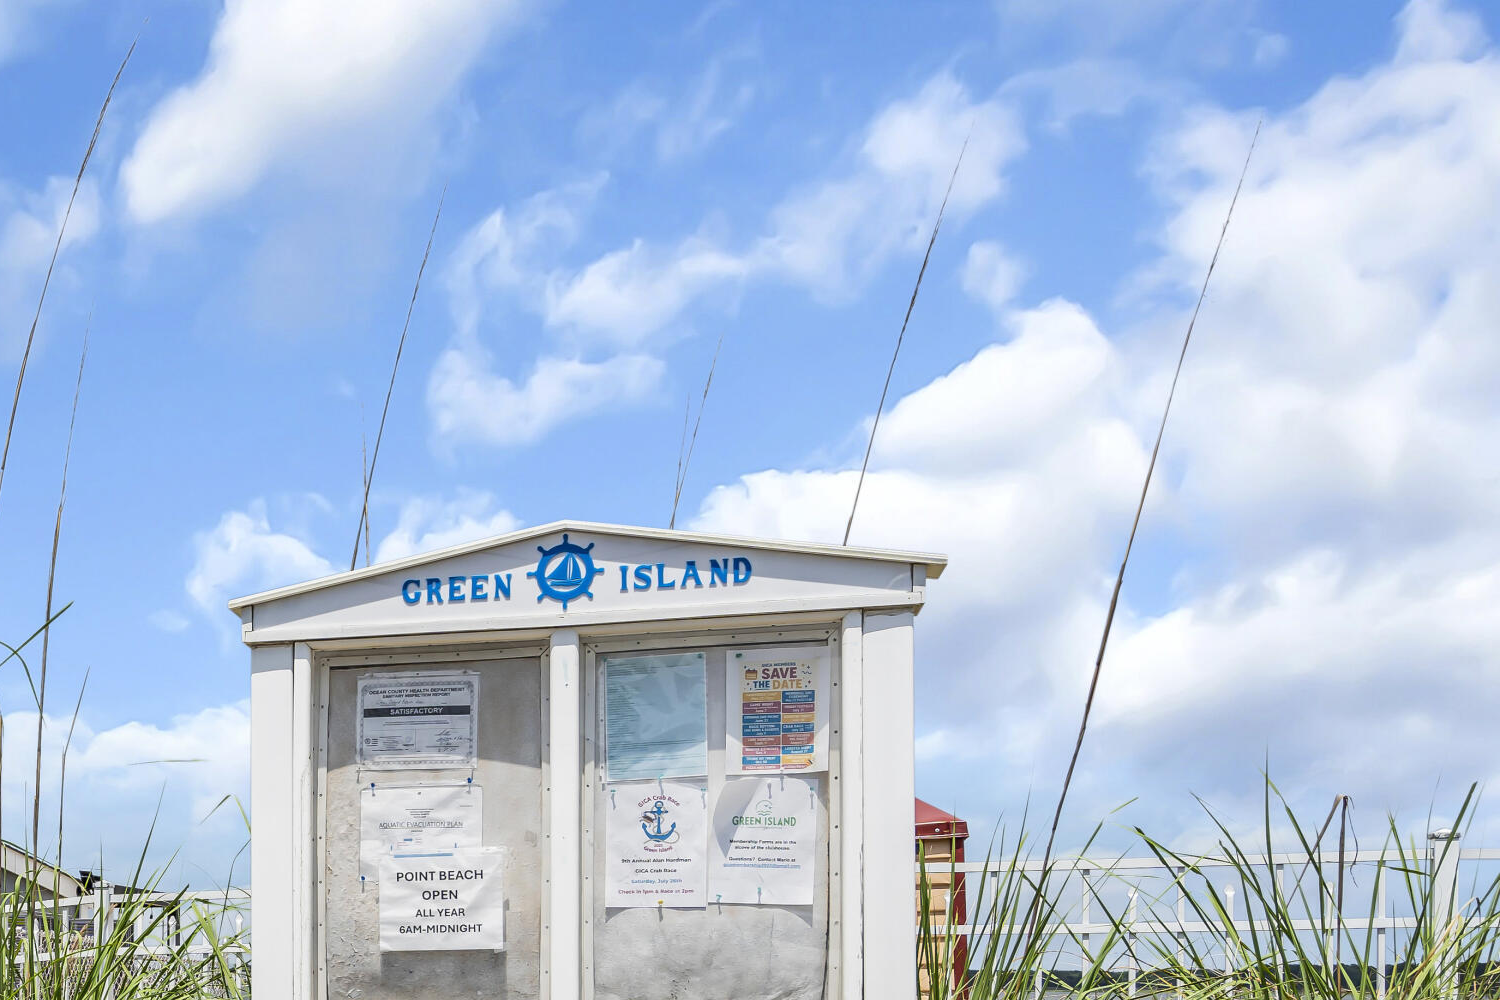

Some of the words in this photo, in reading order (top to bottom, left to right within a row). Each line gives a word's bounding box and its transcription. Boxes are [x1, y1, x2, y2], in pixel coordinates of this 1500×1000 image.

[401, 573, 513, 604] GREEN
[619, 557, 754, 594] ISLAND
[761, 667, 798, 680] SAVE
[753, 680, 770, 689] THE
[772, 679, 802, 690] DATE
[390, 707, 443, 715] SATISFACTORY
[637, 797, 652, 808] GICA
[667, 796, 681, 807] Race
[379, 821, 406, 829] AQUATIC
[732, 815, 761, 826] GREEN
[764, 817, 797, 827] ISLAND
[396, 871, 435, 882] POINT
[439, 869, 484, 881] BEACH
[422, 890, 458, 900] OPEN
[415, 908, 435, 917] ALL
[437, 908, 465, 917] YEAR
[399, 924, 483, 934] 6AM-MIDNIGHT
